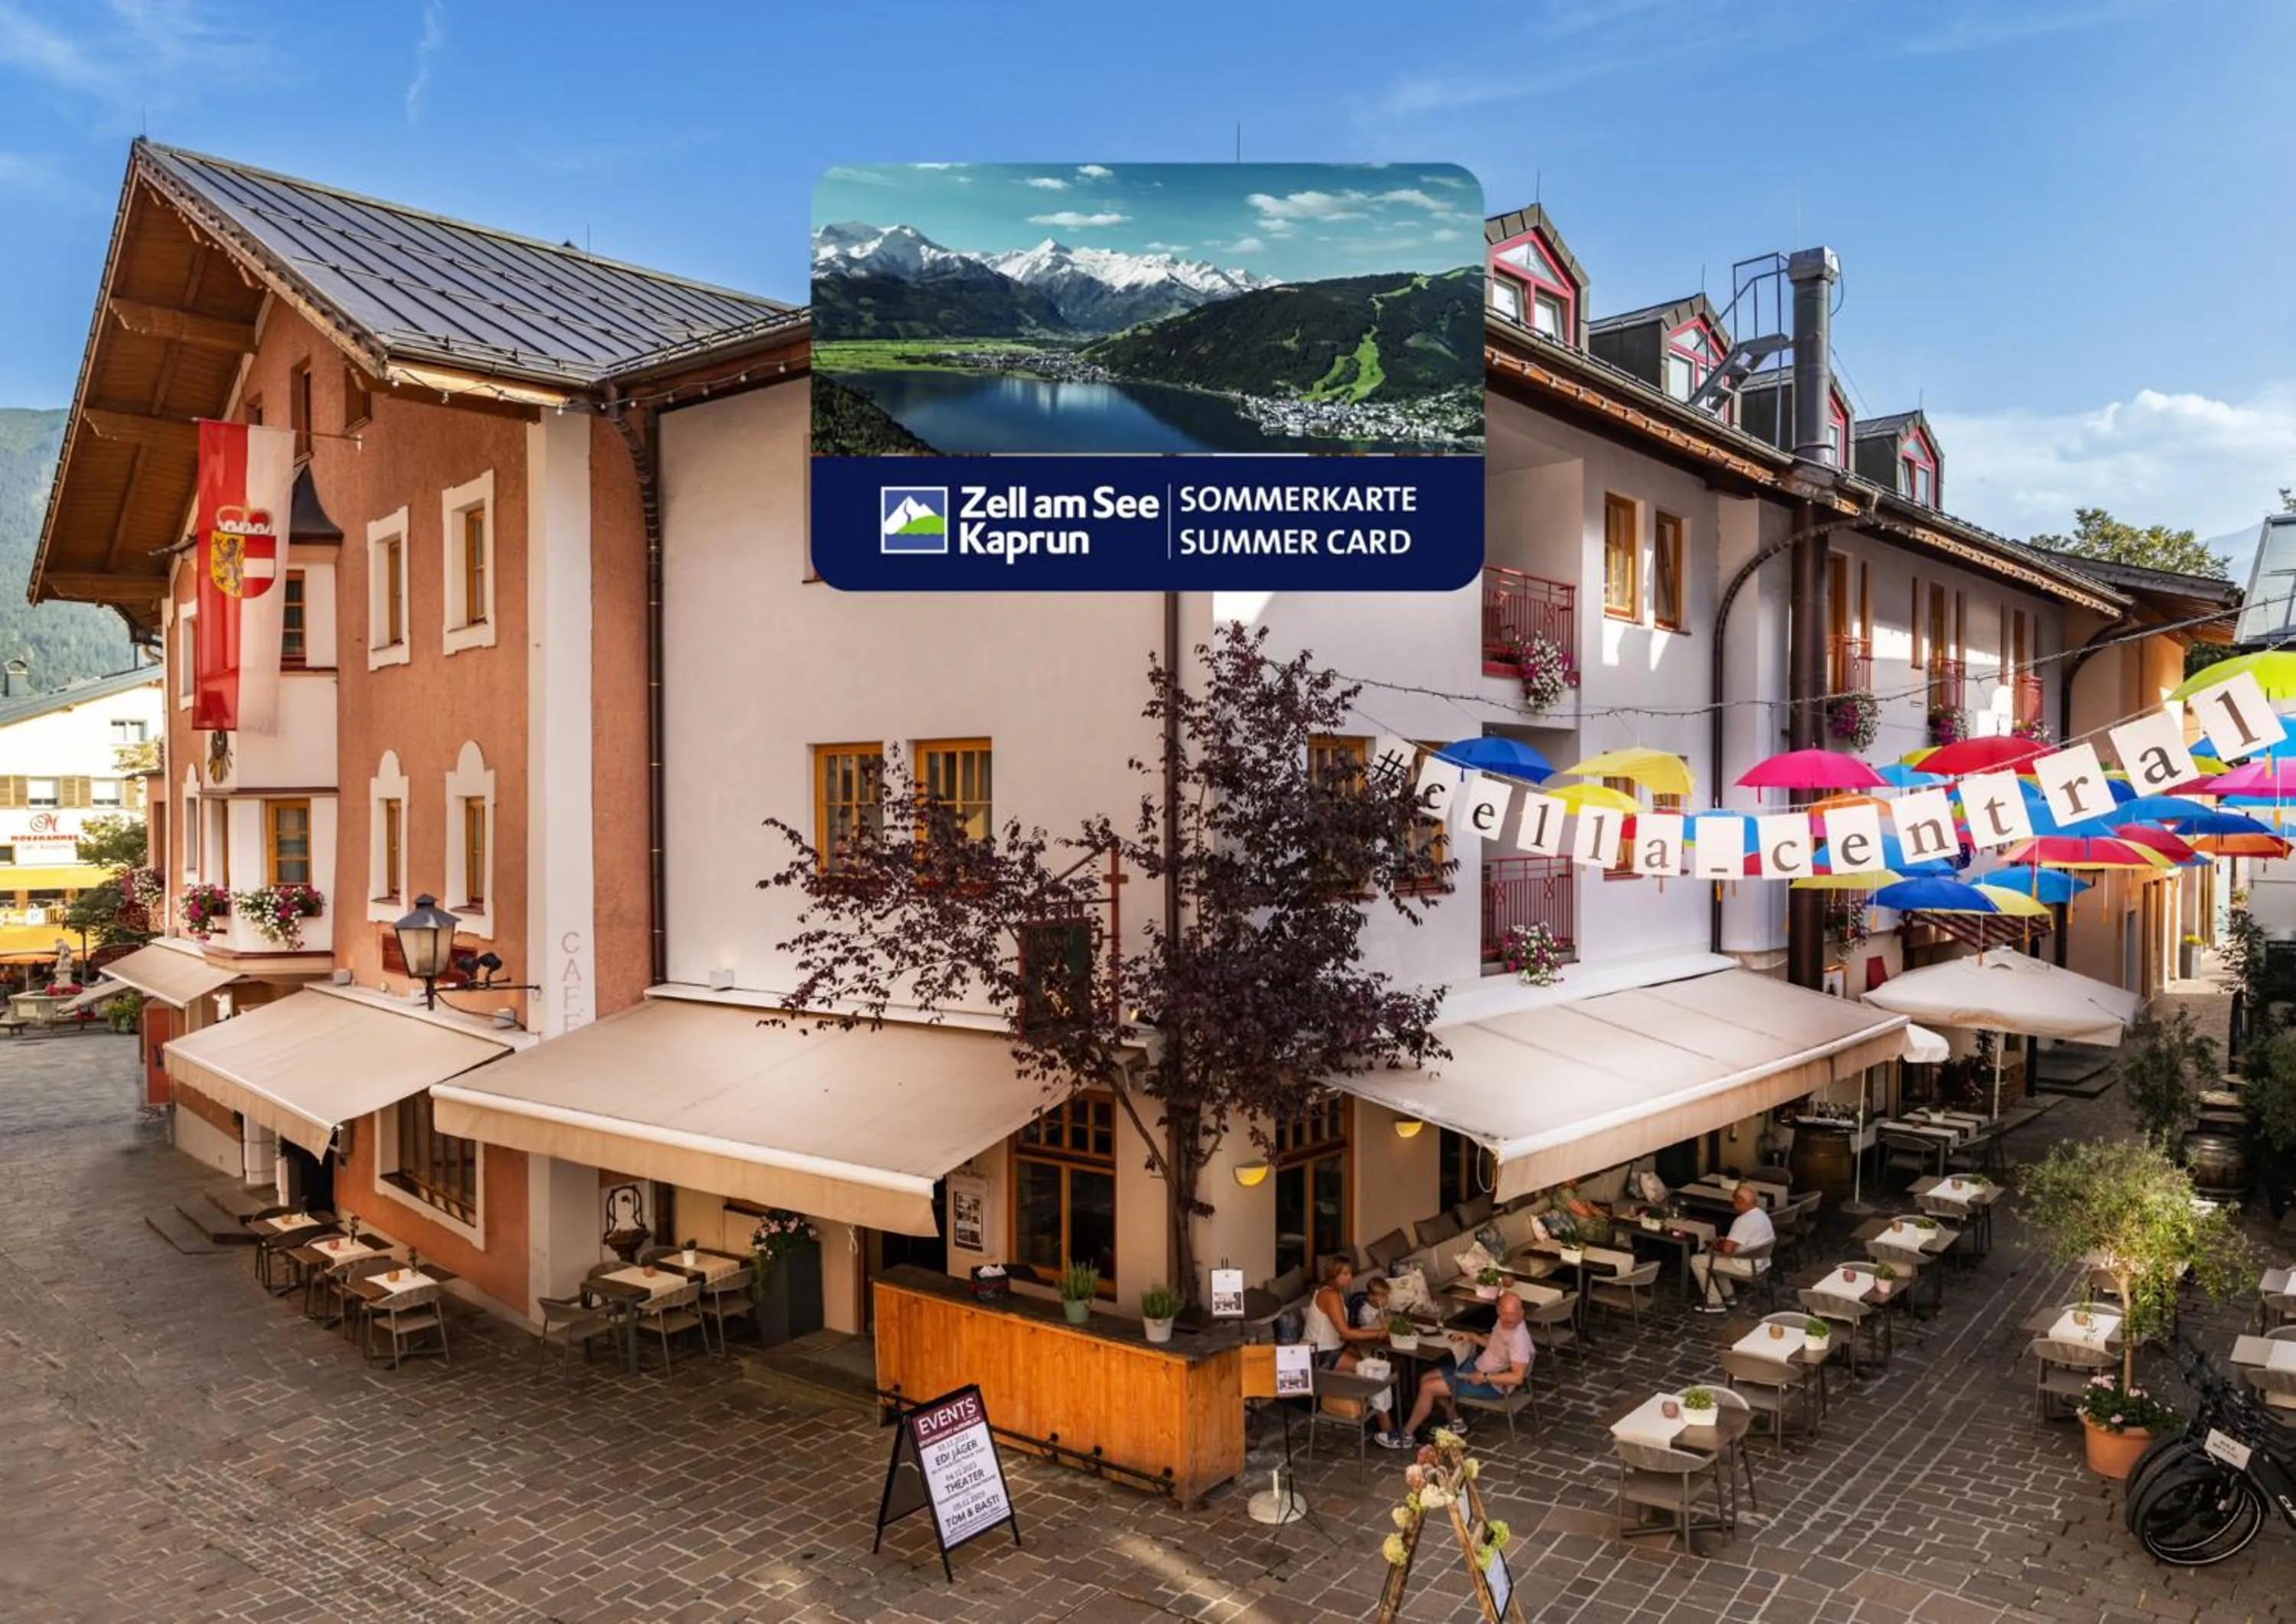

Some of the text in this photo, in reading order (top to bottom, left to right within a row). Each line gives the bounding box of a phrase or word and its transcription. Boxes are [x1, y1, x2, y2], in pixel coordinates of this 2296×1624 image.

[918, 1397, 977, 1435] EVENTS
[944, 1469, 985, 1493] THEATER
[945, 1512, 966, 1528] TOM
